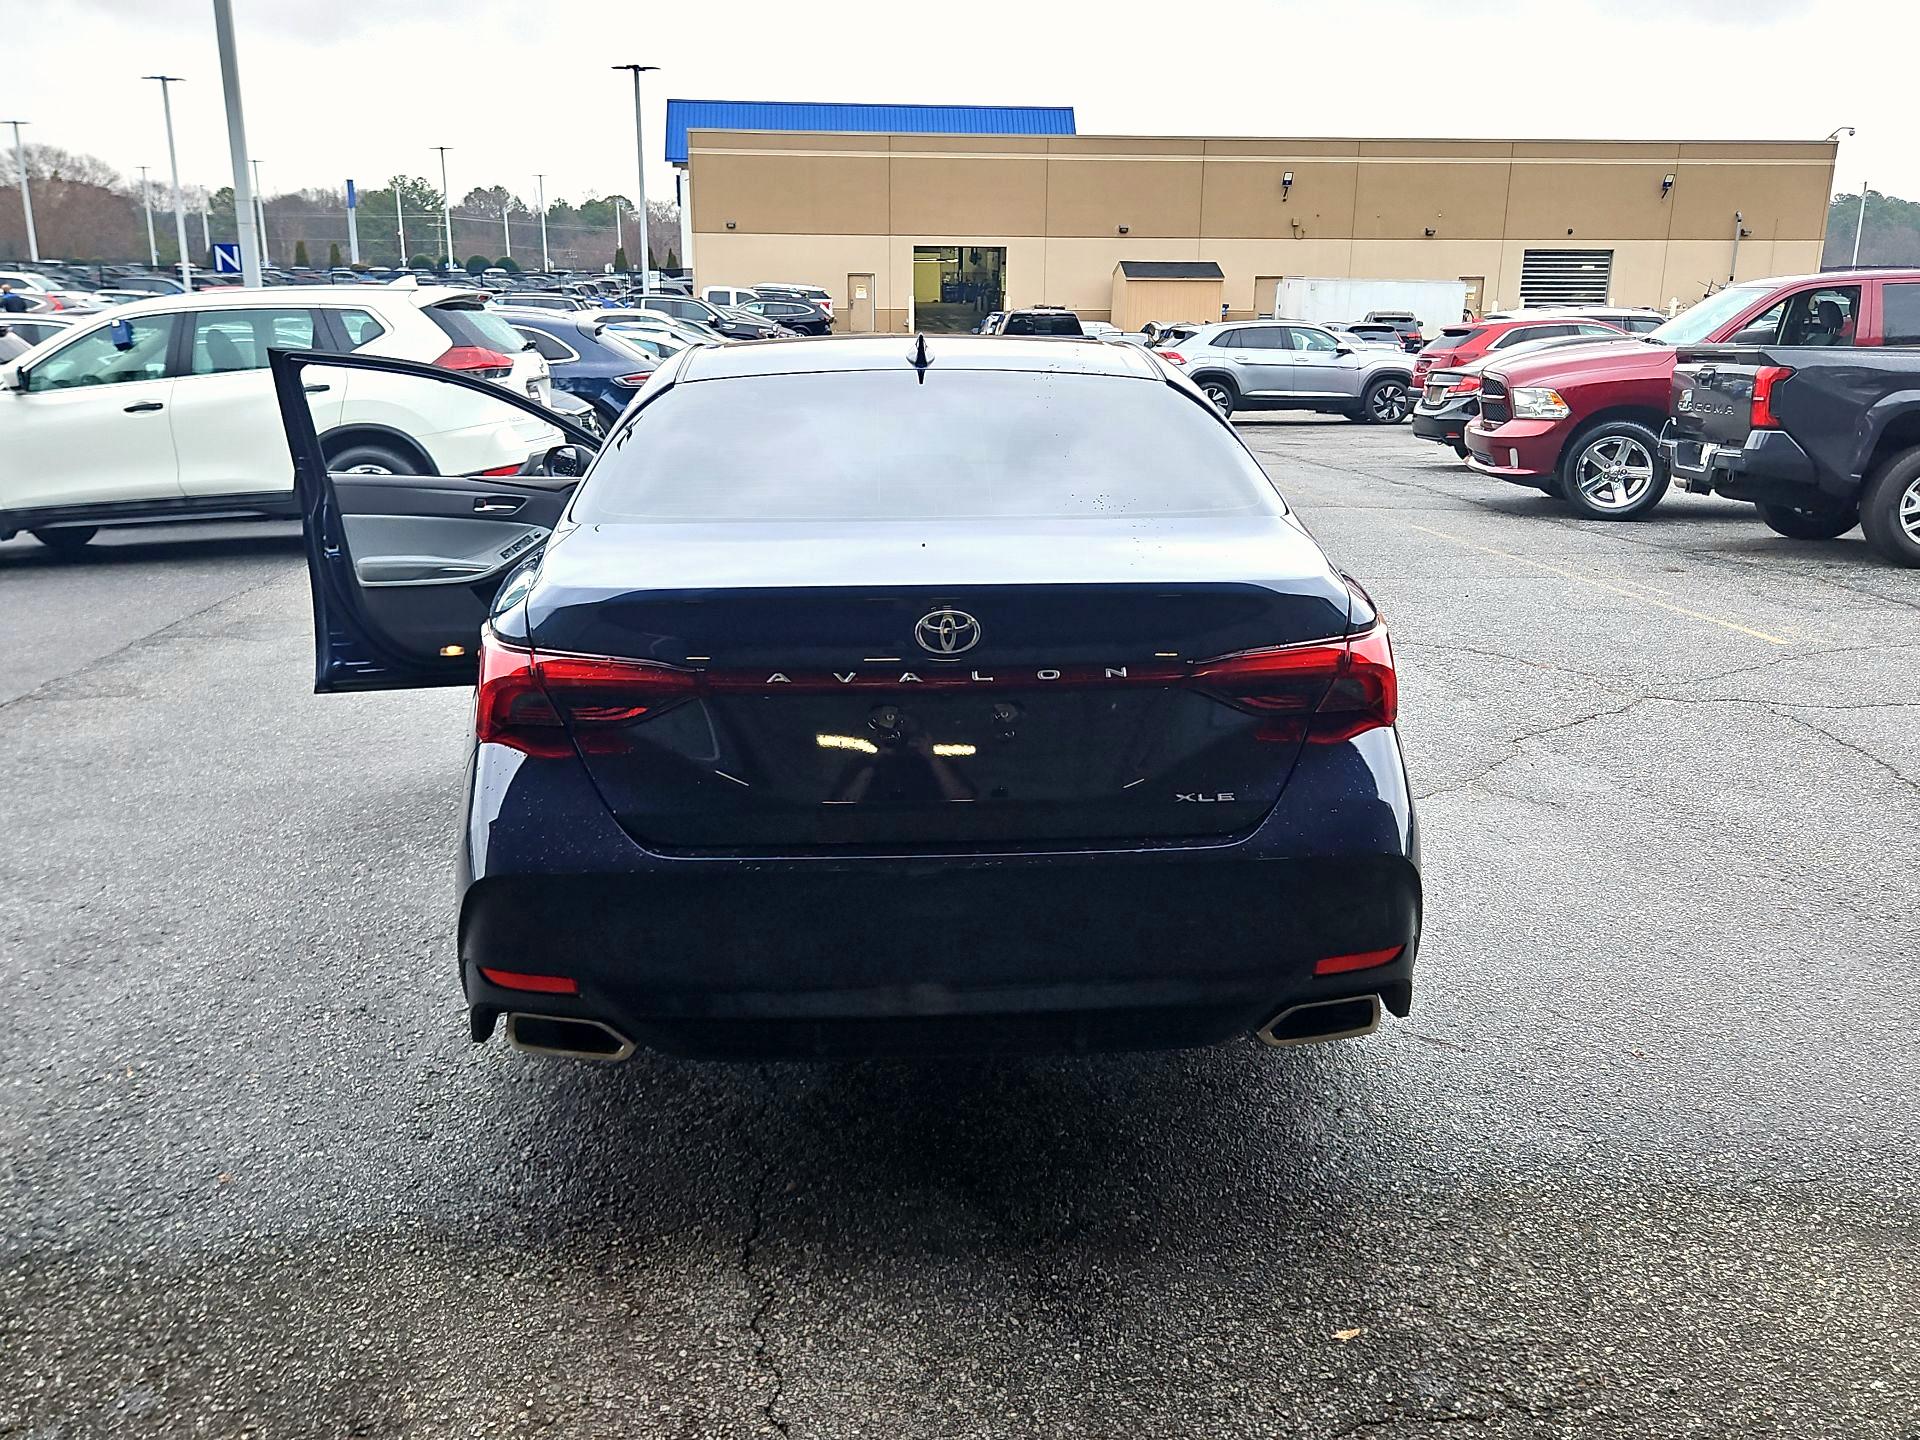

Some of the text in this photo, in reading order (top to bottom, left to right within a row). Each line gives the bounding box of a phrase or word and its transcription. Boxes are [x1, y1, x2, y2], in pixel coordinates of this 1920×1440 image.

[214, 245, 241, 272] N
[766, 666, 1128, 684] AVALON
[1175, 792, 1236, 802] XLE
